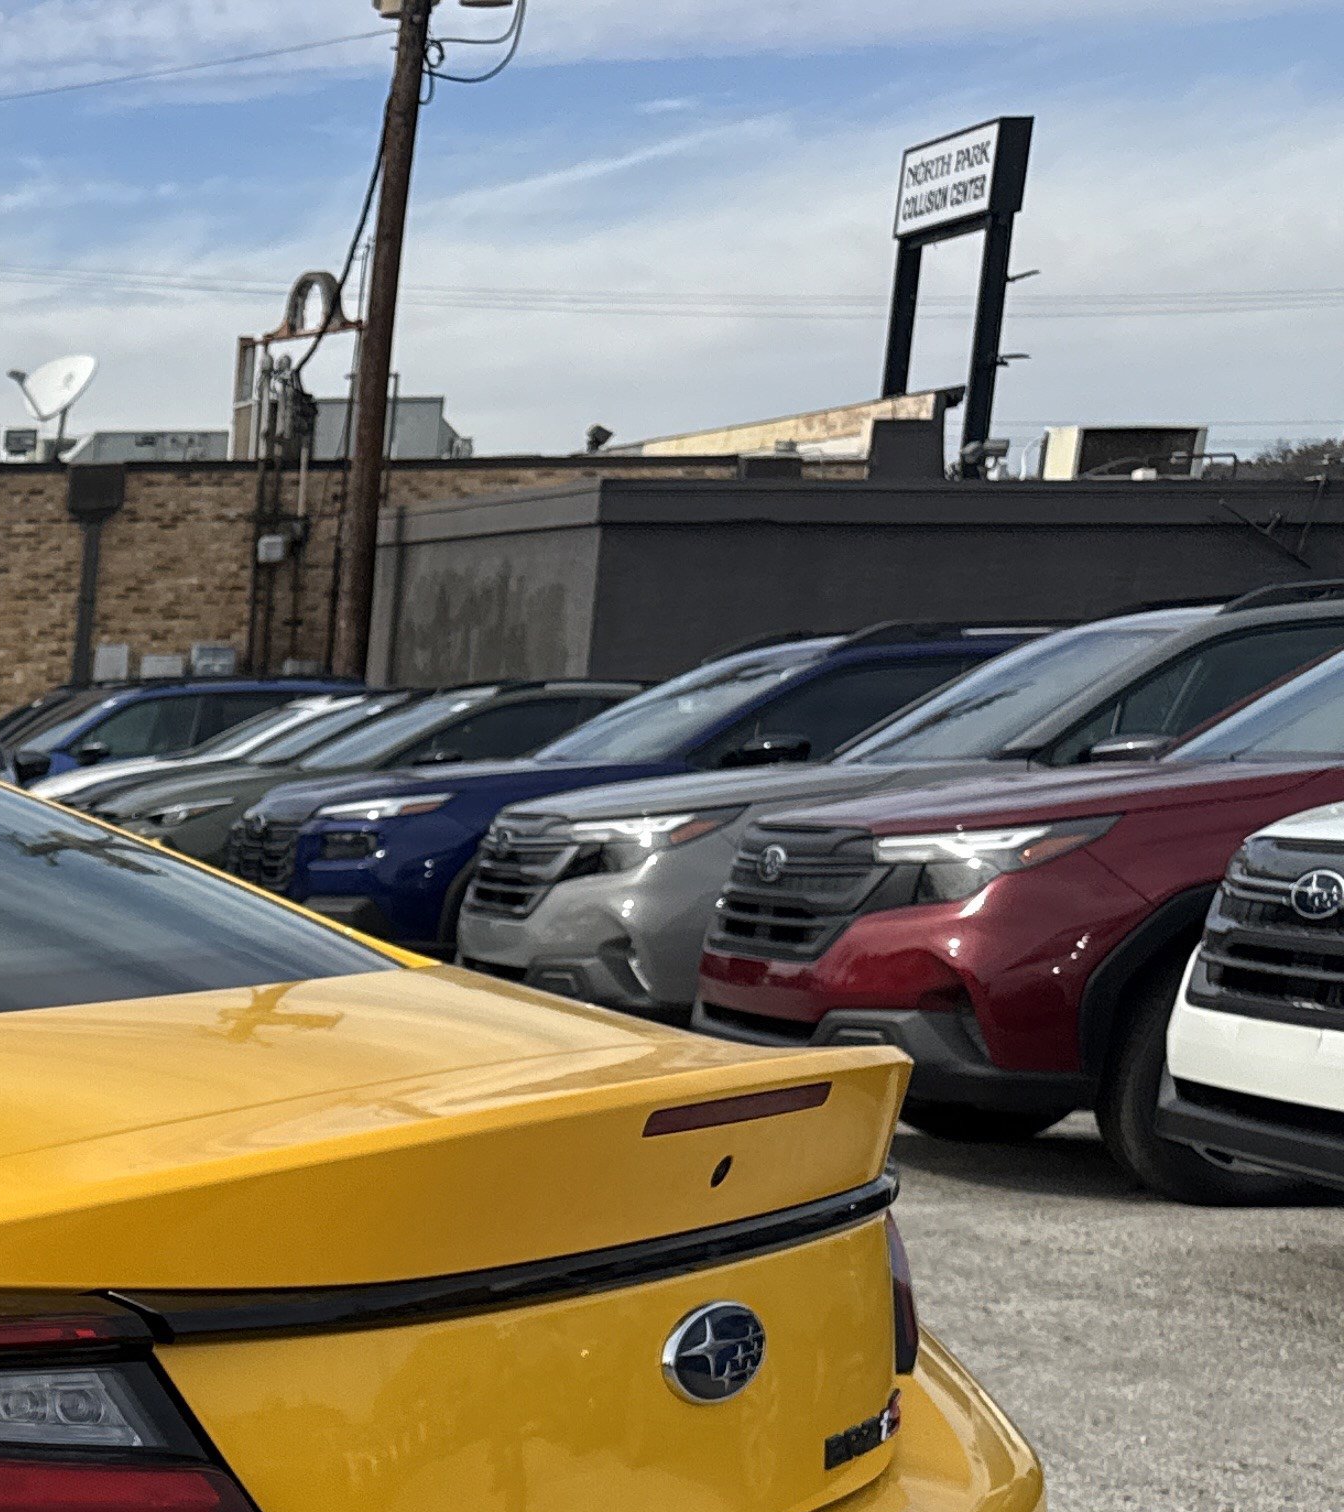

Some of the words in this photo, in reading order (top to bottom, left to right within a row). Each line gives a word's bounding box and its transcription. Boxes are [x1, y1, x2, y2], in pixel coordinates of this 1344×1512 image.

[905, 153, 953, 189] NORTH
[954, 140, 991, 172] PARK
[902, 185, 949, 221] COLLISION
[950, 174, 986, 207] CENTER
